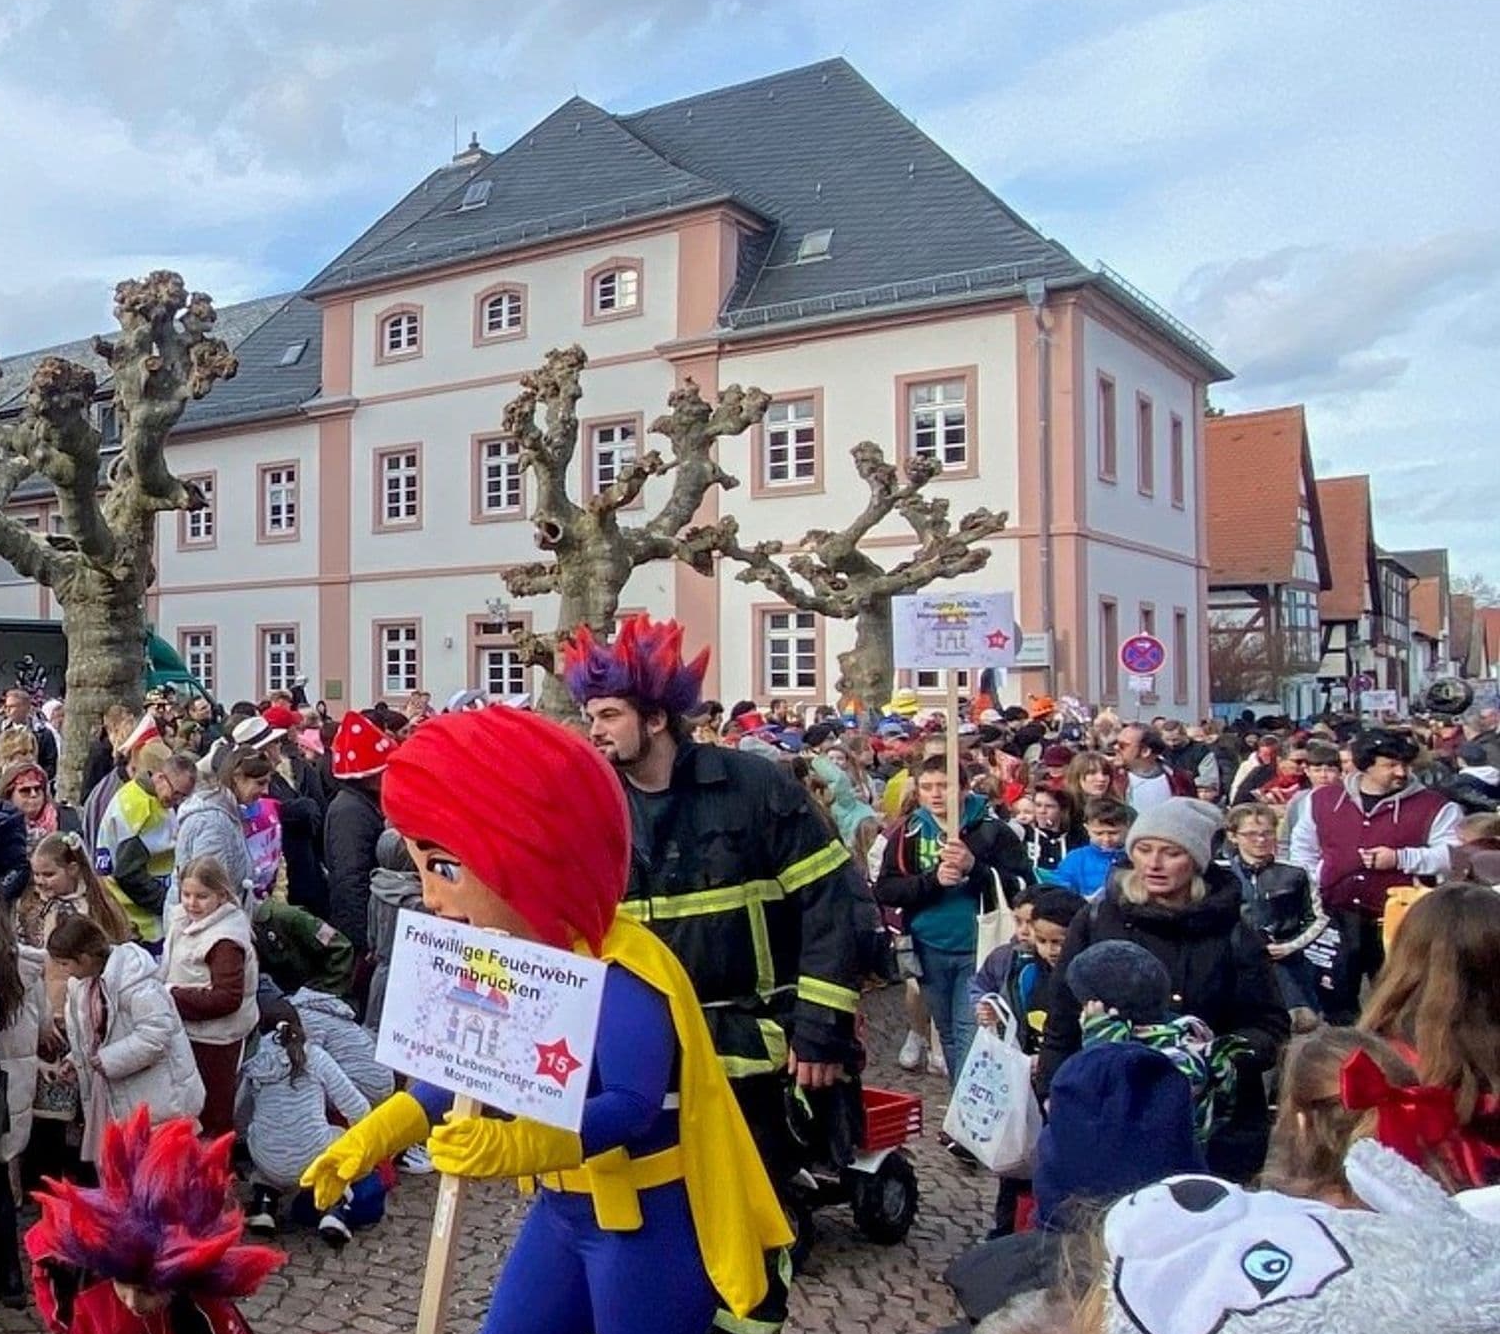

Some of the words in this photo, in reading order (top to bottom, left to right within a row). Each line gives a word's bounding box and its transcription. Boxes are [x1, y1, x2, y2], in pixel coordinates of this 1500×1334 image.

[404, 924, 485, 962] Freiwillige
[487, 947, 589, 990] Feuerwehr
[432, 956, 541, 1002] Rembrücken
[392, 1030, 408, 1045] Wir
[409, 1040, 435, 1056] sind
[435, 1045, 454, 1064] die
[456, 1053, 536, 1091] Lebensretter
[537, 1081, 564, 1100] von
[444, 1065, 493, 1093] Morgen!
[544, 1051, 568, 1074] 15
